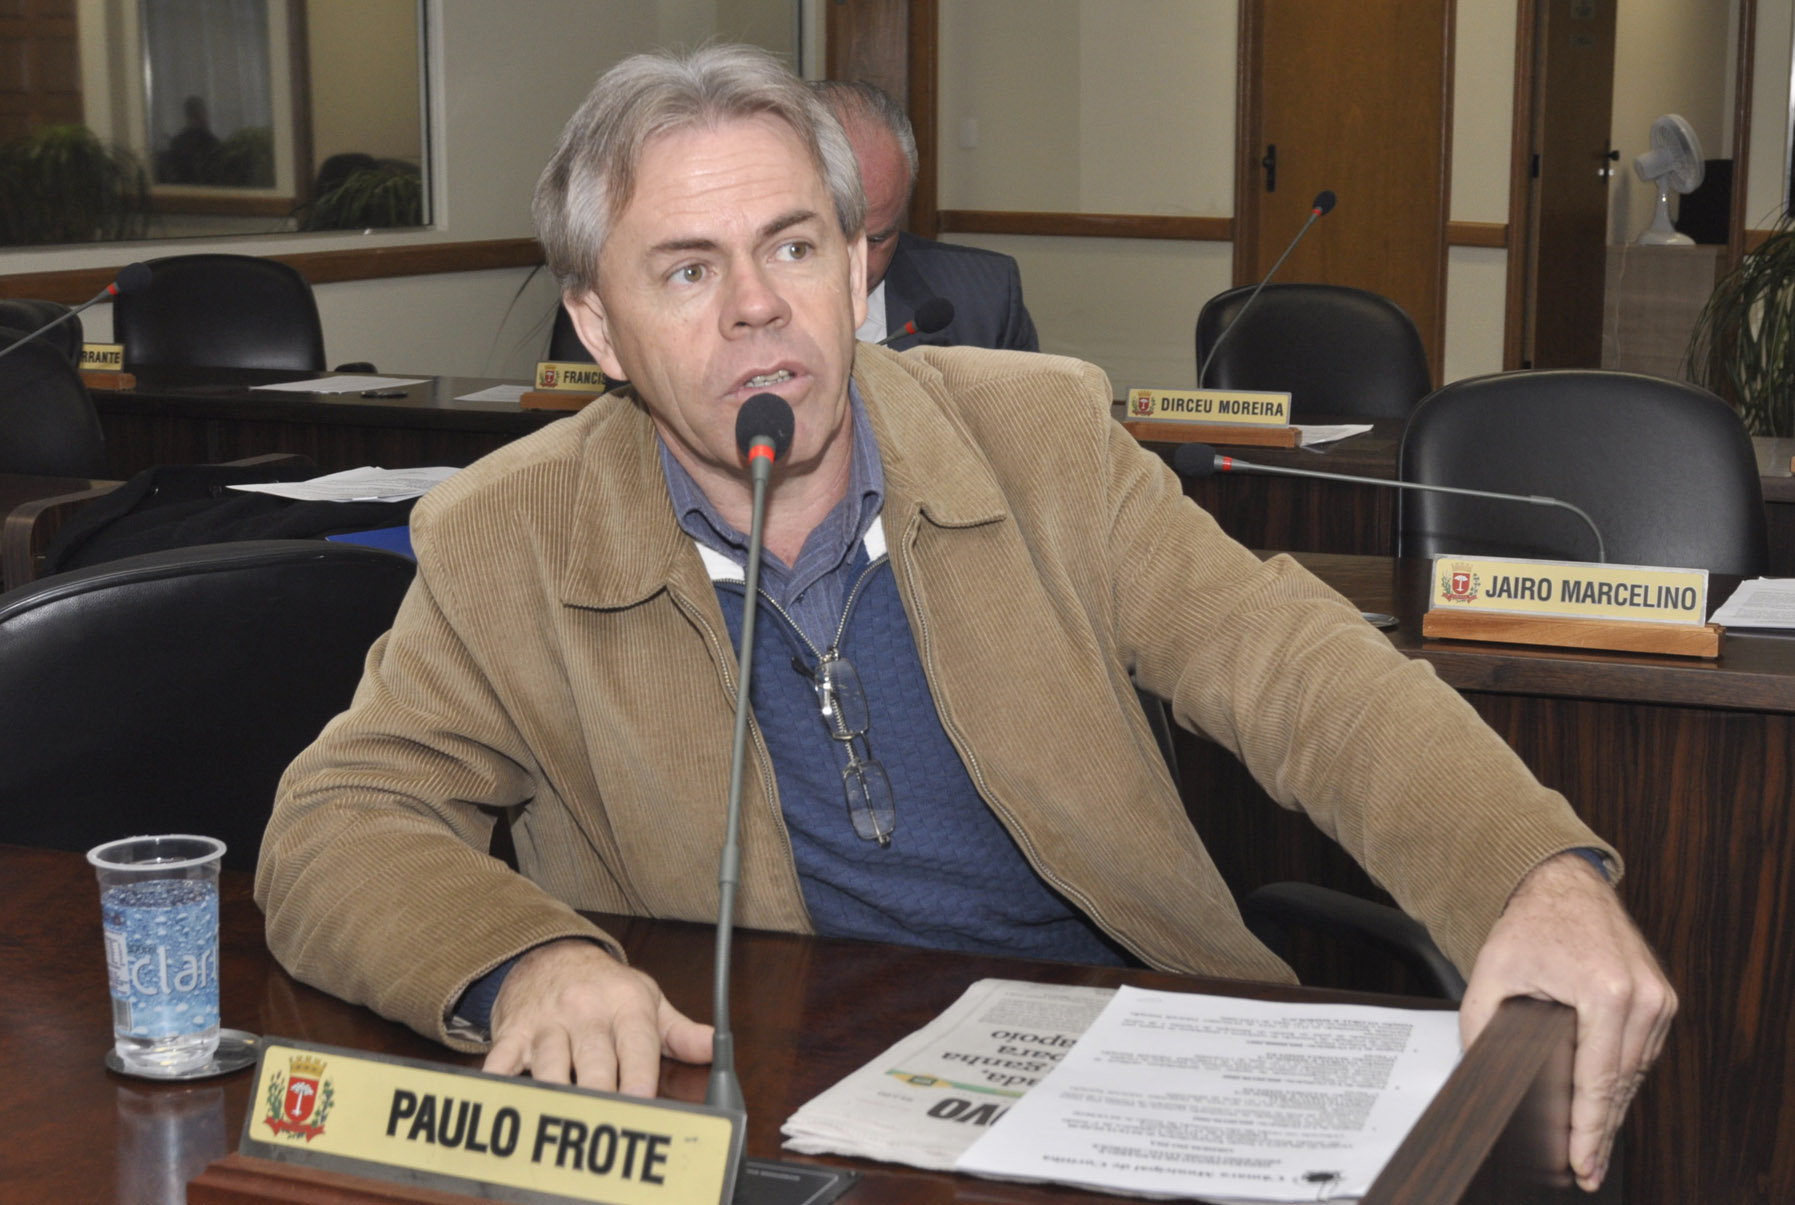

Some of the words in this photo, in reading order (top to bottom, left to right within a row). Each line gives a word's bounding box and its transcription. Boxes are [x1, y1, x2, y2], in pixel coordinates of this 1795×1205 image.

[1160, 397, 1213, 413] DIRCEU
[1218, 400, 1284, 417] MOREIRA
[1485, 574, 1553, 602] JAIRO
[1560, 579, 1697, 612] MARCELINO
[991, 1030, 1078, 1048] apoio
[941, 1051, 1047, 1073] ganha
[926, 1097, 1011, 1127] VO
[385, 1088, 522, 1158] PAULO
[531, 1114, 672, 1186] FROTE
